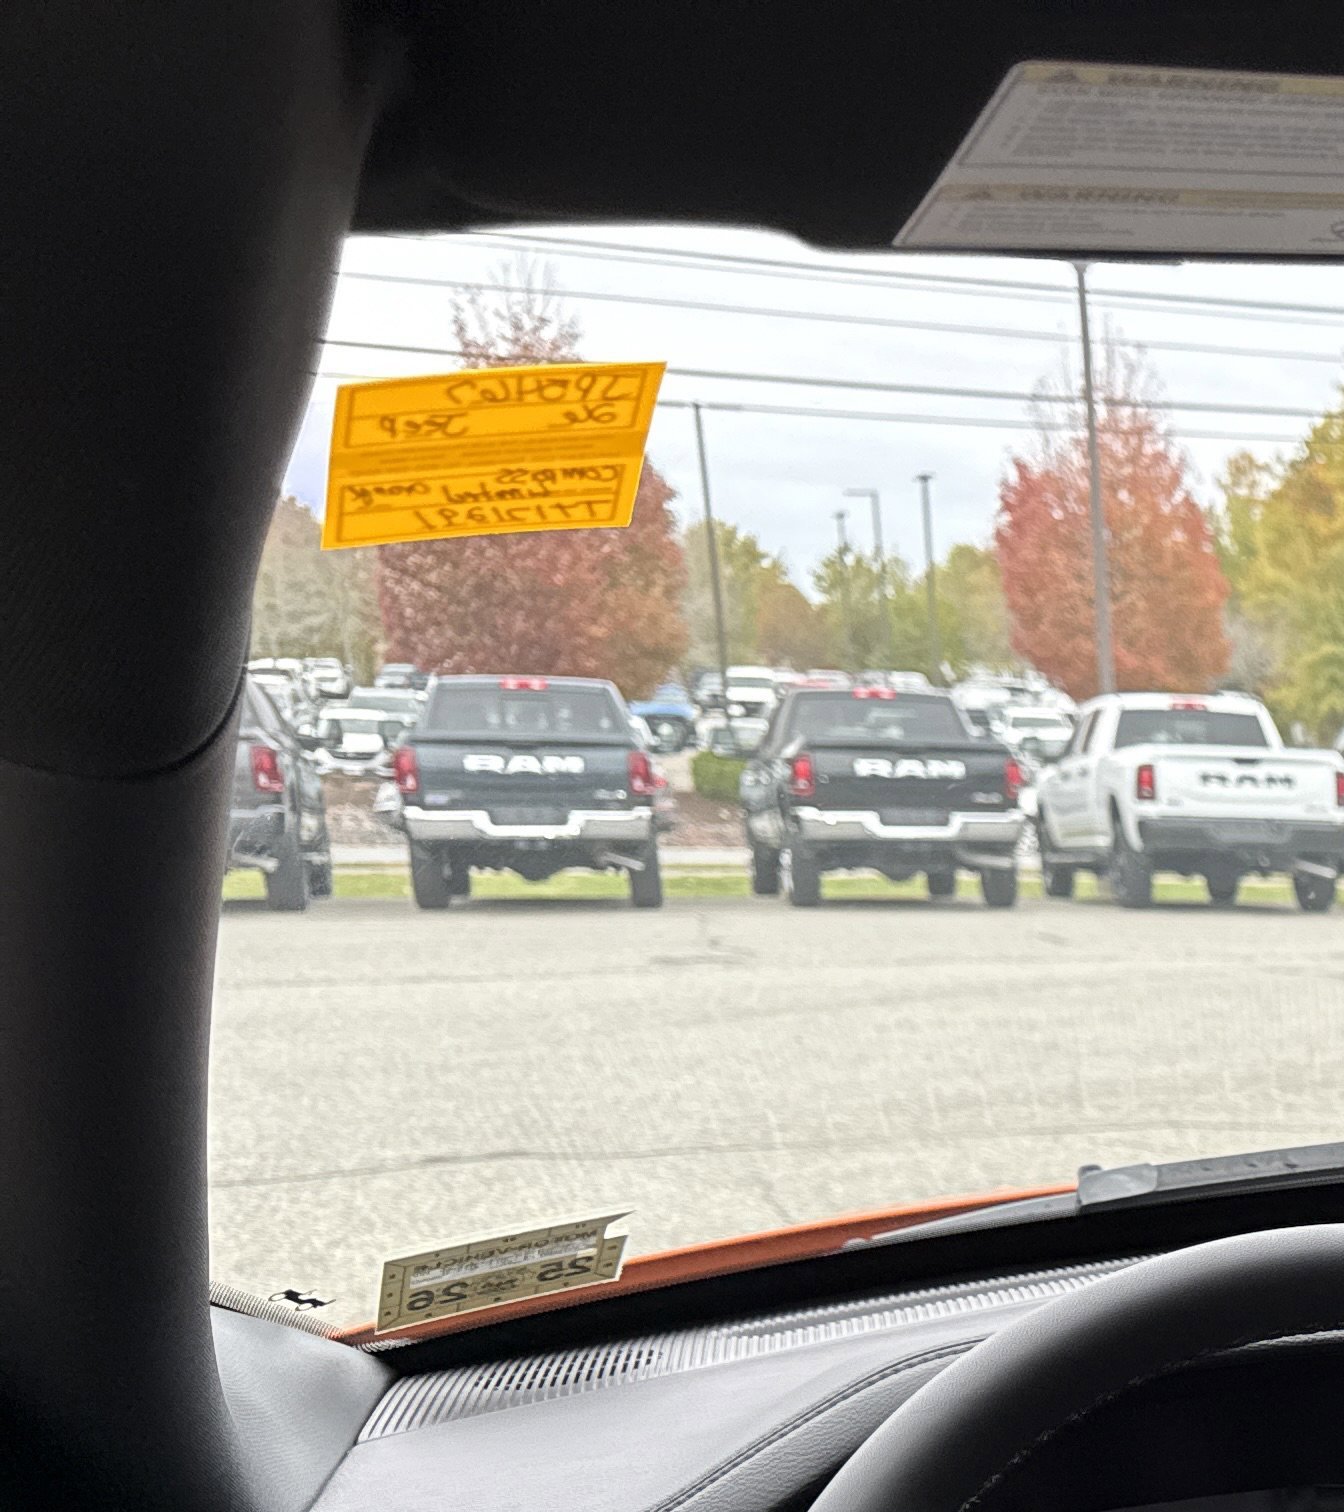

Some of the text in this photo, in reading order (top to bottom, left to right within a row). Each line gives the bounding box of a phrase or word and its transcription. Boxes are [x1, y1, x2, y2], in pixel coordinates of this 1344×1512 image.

[1107, 72, 1281, 94] WARNING
[1017, 184, 1181, 204] WARNING
[463, 754, 585, 774] RAM
[853, 758, 966, 779] RAM
[1200, 773, 1295, 790] RAM
